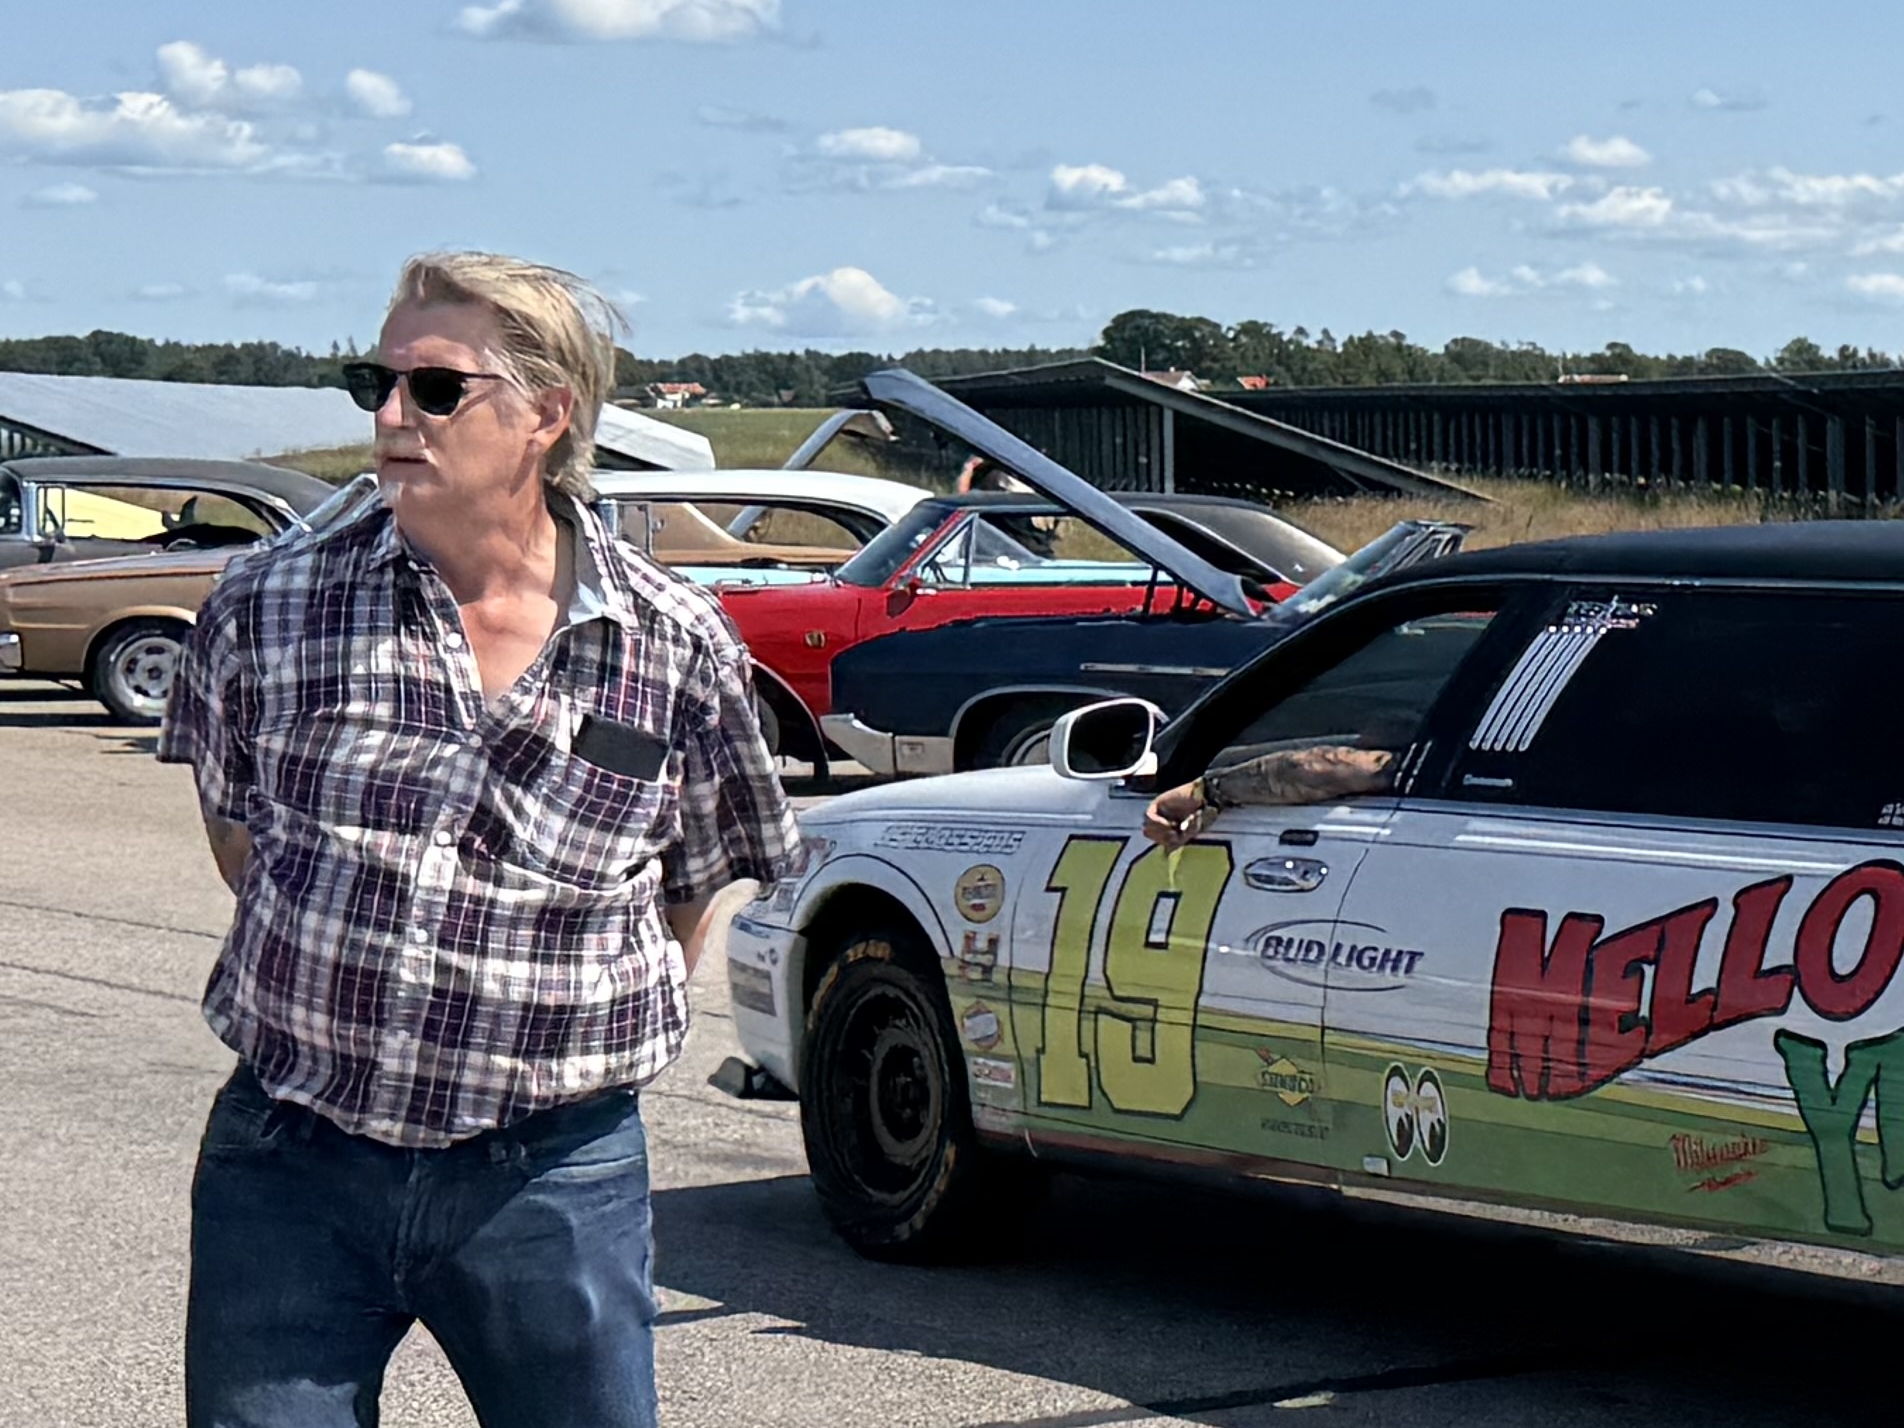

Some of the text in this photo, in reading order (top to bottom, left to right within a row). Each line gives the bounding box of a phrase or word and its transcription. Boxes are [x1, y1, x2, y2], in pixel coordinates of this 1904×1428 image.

[1037, 833, 1236, 1121] 19
[1260, 934, 1425, 975] BUD LIGHT
